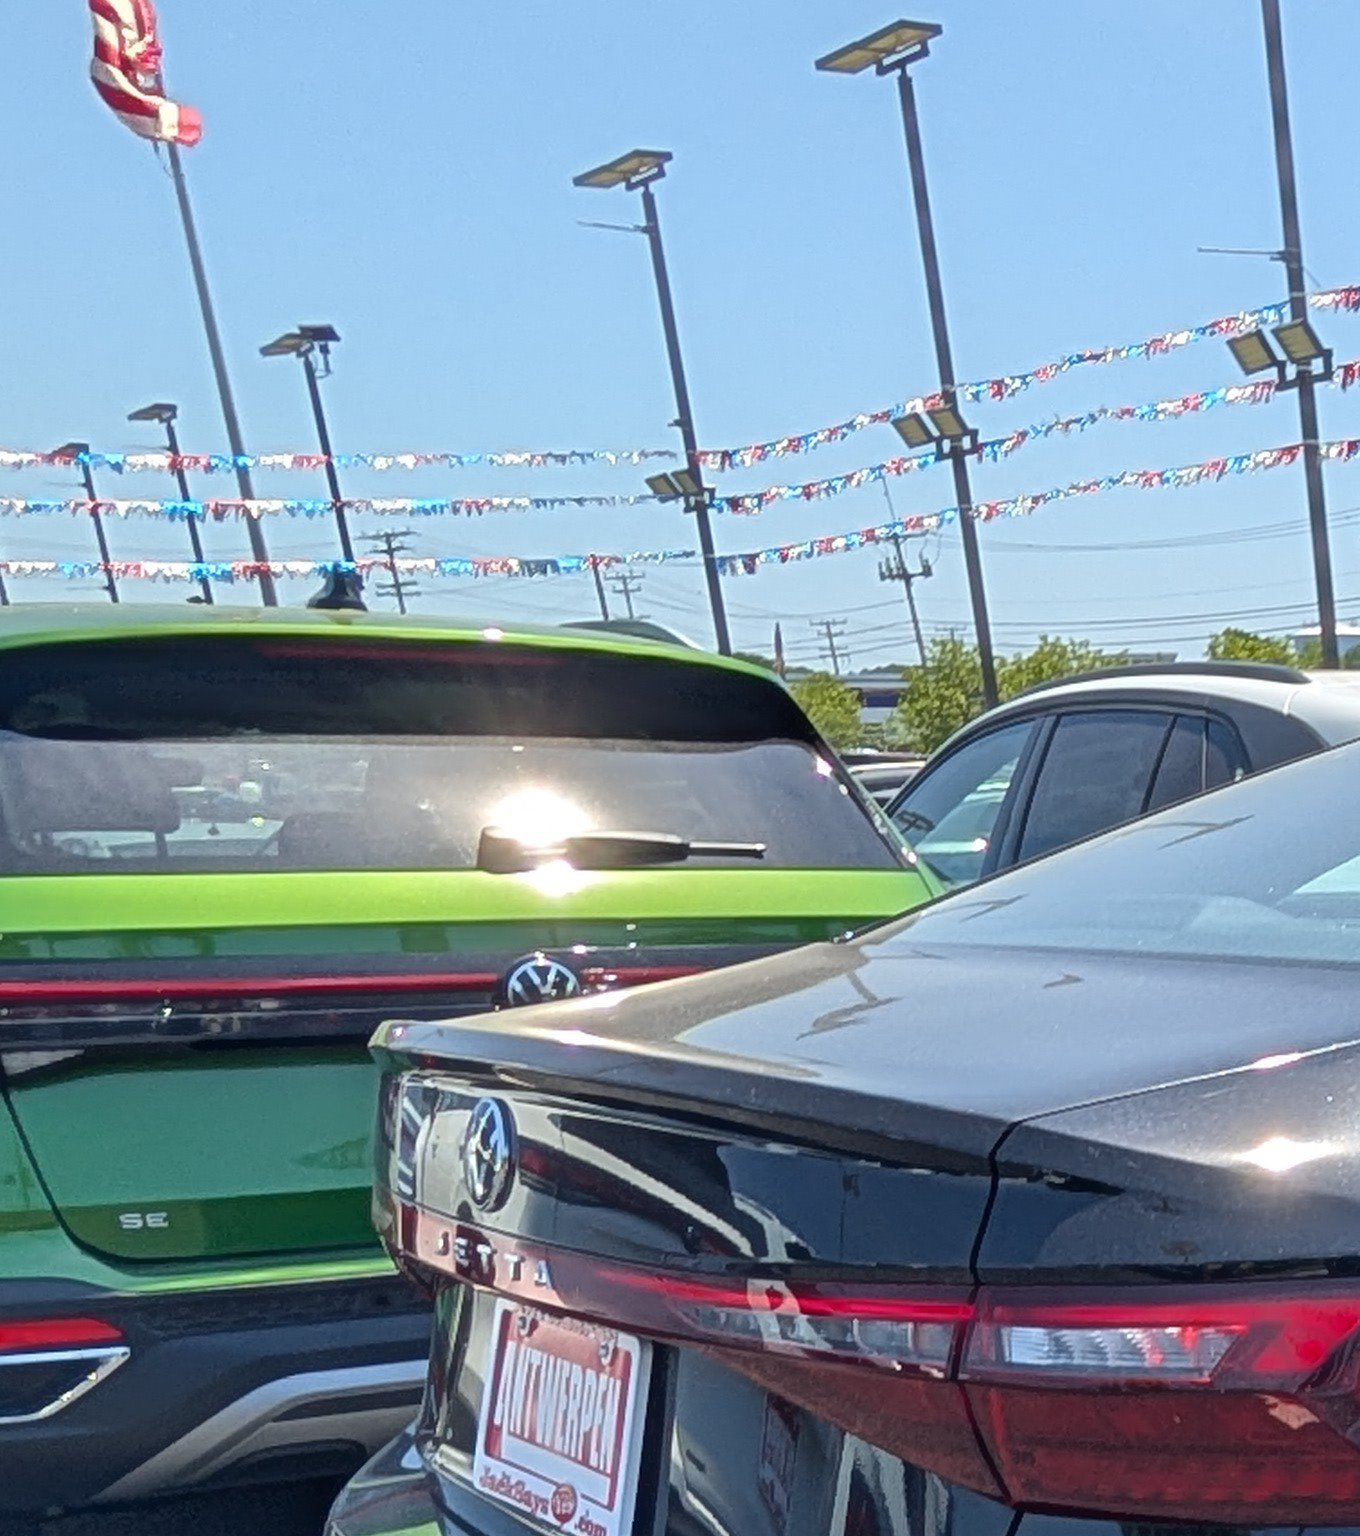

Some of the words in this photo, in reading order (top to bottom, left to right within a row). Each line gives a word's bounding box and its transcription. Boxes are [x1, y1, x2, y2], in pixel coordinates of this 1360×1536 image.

[119, 1211, 169, 1229] SE
[434, 1231, 553, 1289] JETTA
[494, 1340, 621, 1475] ANTWERPEN
